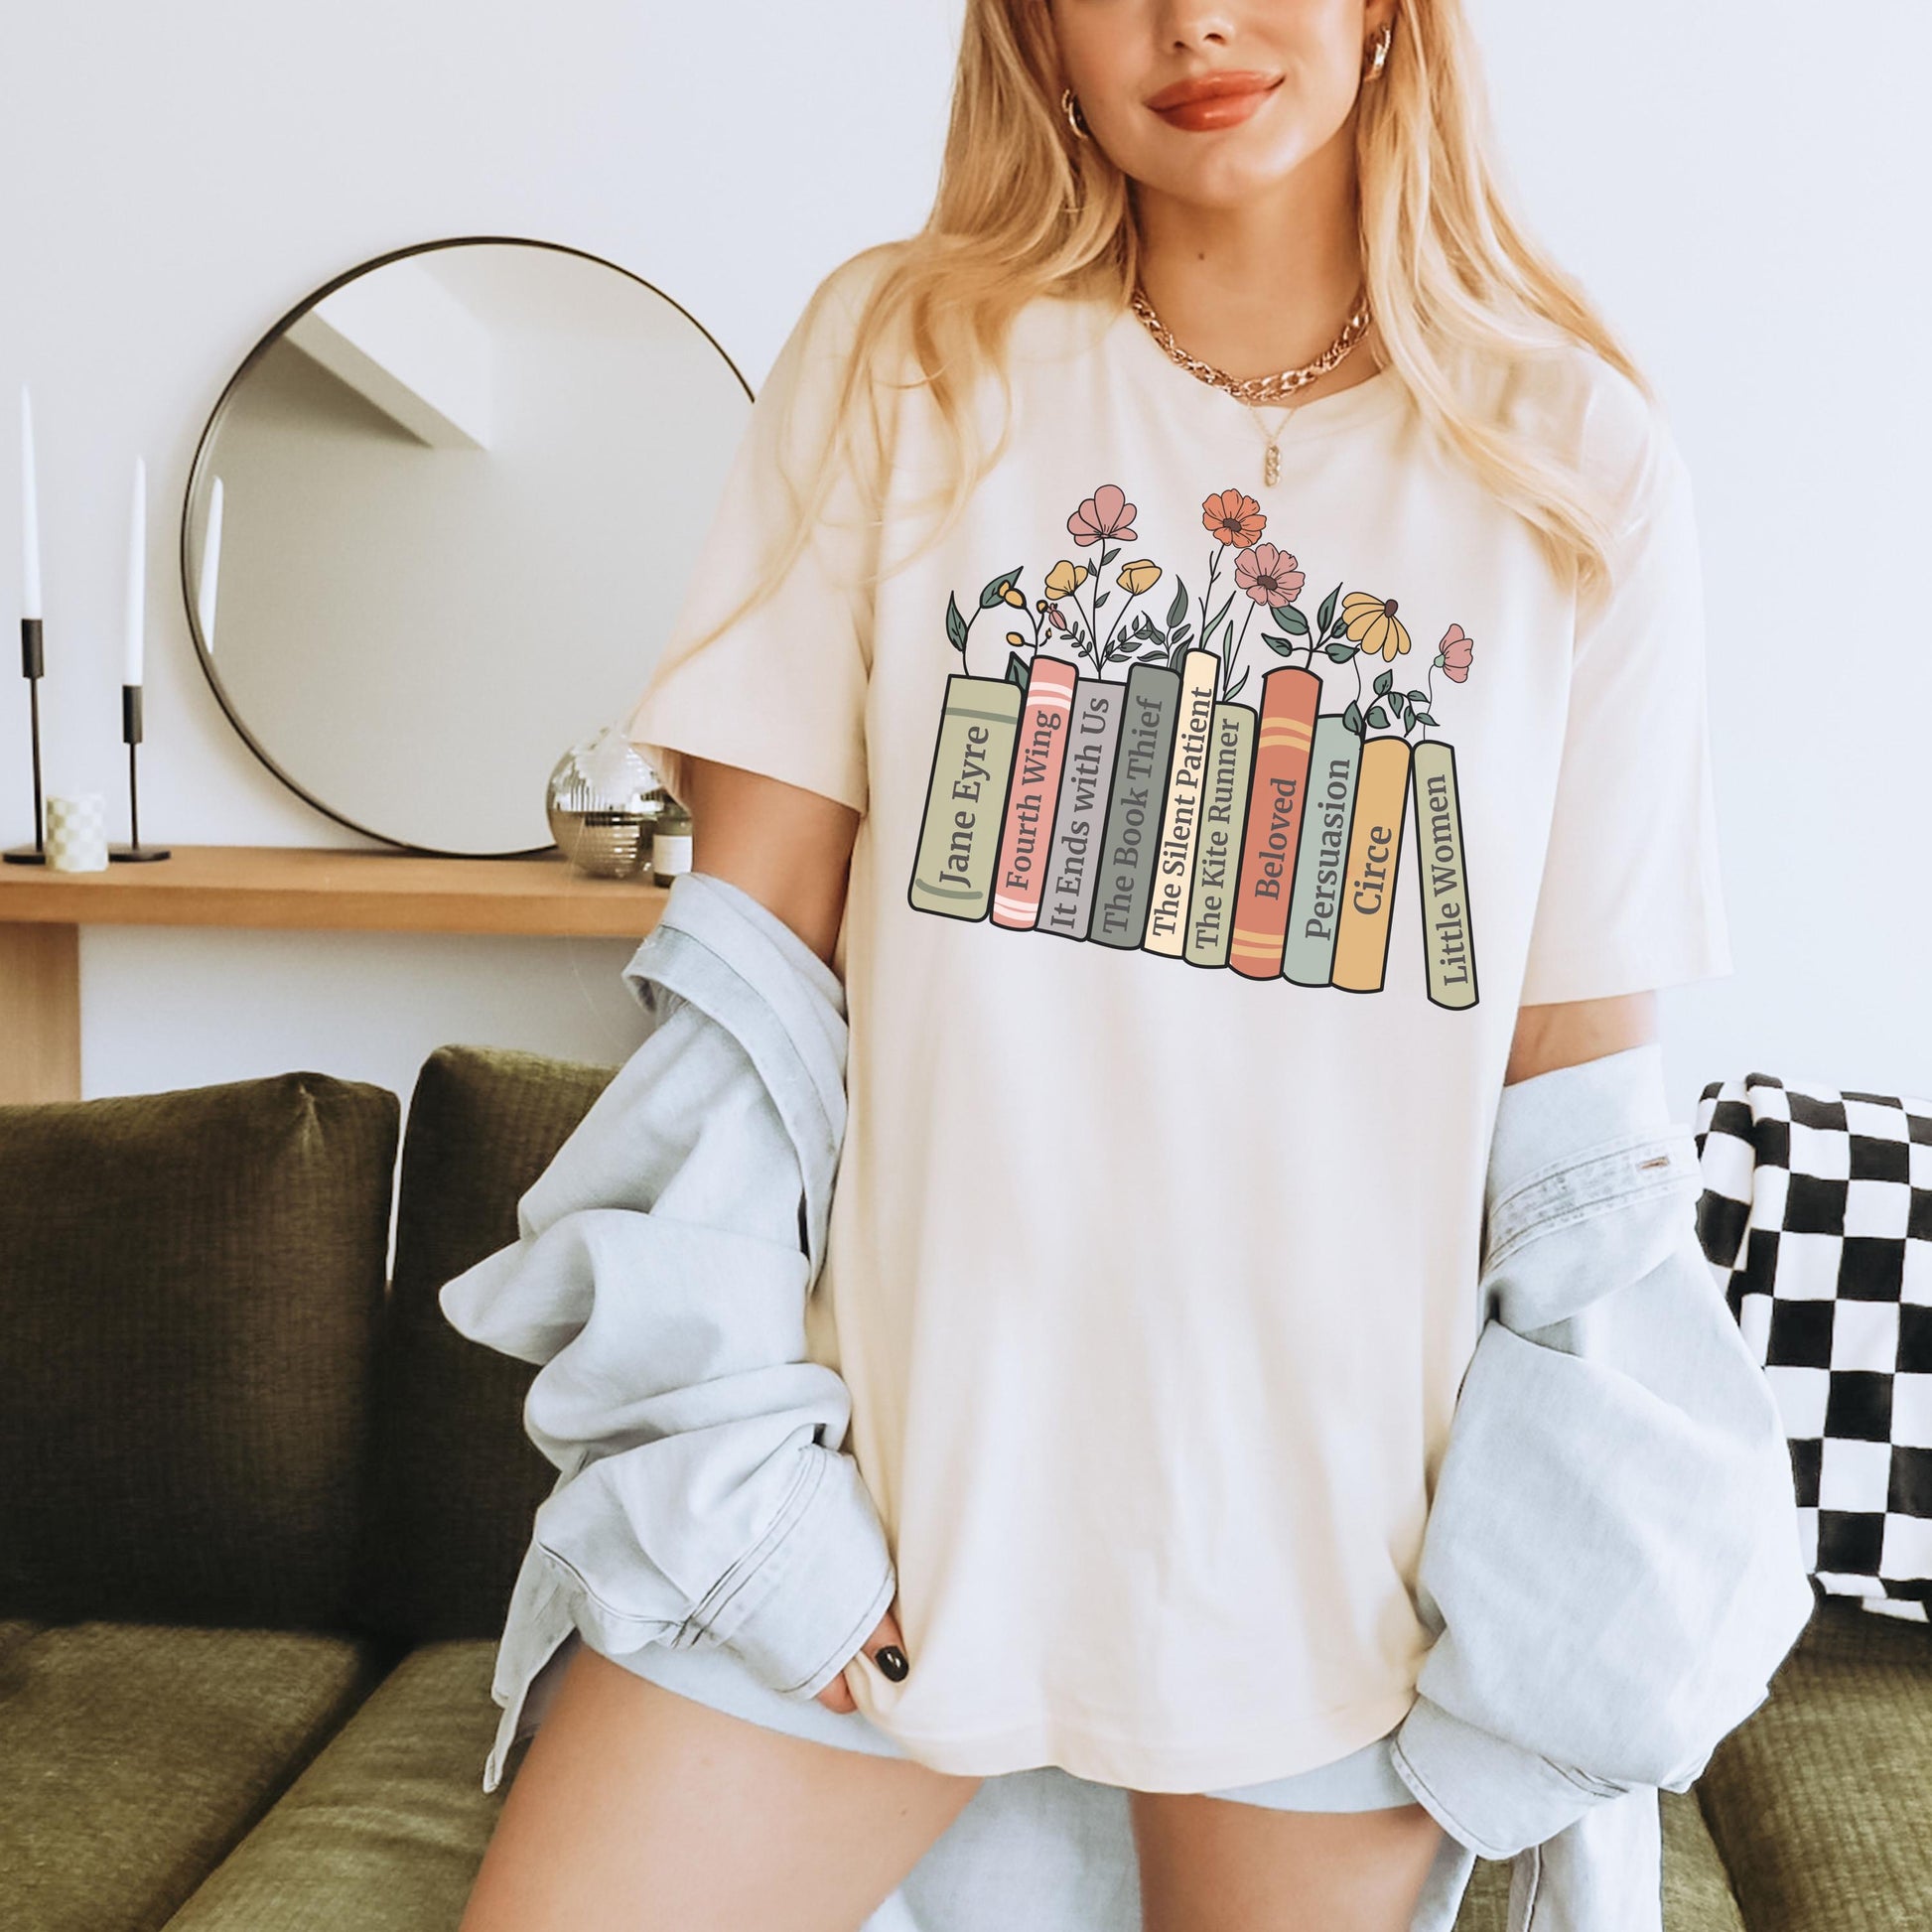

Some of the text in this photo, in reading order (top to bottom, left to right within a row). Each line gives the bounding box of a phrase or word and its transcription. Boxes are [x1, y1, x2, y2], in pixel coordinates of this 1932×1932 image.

[938, 726, 991, 889] Jane Eyre
[1006, 711, 1061, 890] Fourth Wing
[1050, 698, 1109, 929] It Ends with Us
[1103, 696, 1164, 934] The Book Thief
[1152, 686, 1212, 936] The Silent Patient
[1195, 718, 1240, 950] The Kite Runner
[1254, 778, 1297, 898] Beloved
[1305, 759, 1350, 941] Persuasion
[1353, 826, 1392, 915] Circe
[1426, 773, 1468, 986] Little Women
